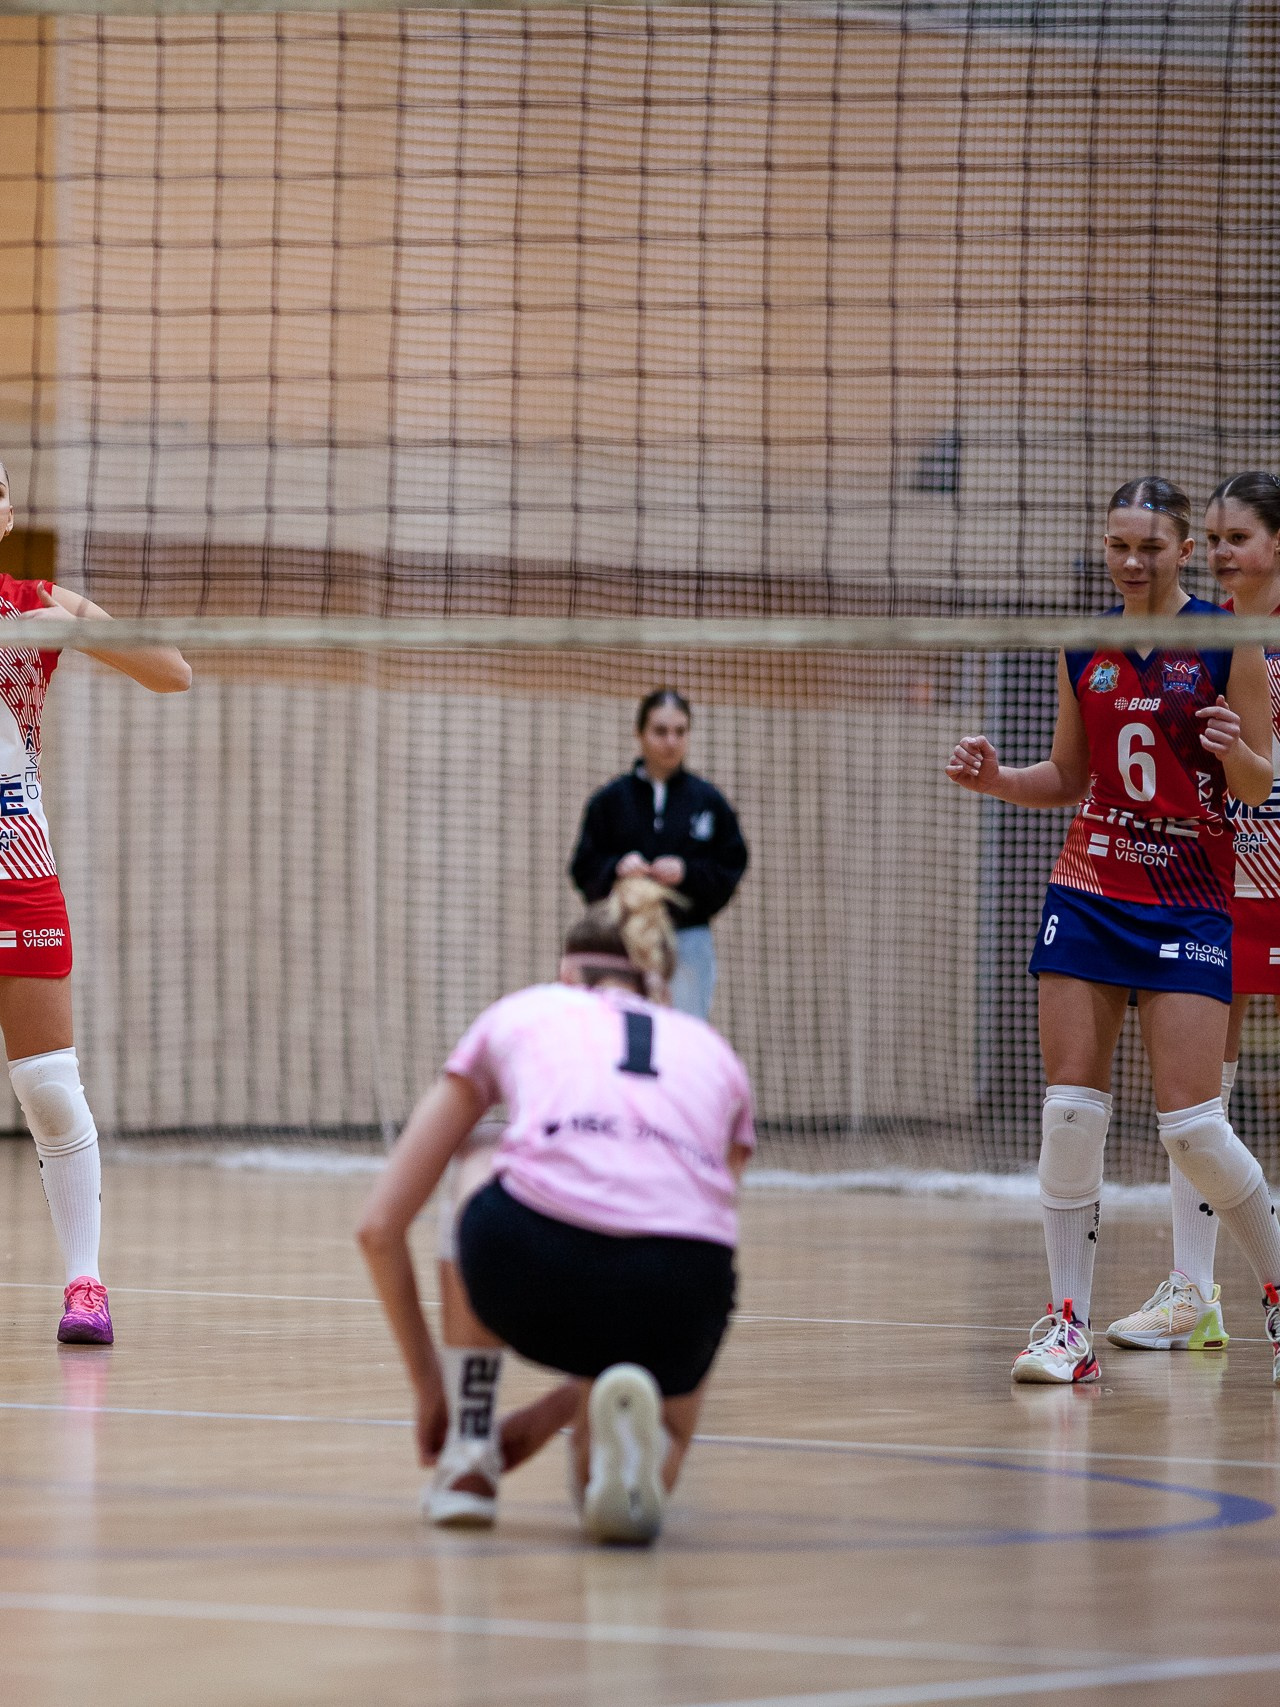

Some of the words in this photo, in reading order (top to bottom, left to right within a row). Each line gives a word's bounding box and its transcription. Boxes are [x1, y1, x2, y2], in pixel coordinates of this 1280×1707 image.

[1128, 698, 1162, 712] ВФВ
[1117, 722, 1156, 802] 6
[1233, 833, 1268, 843] OBAL
[1115, 838, 1179, 857] GLOBAL
[1114, 850, 1168, 868] VISION
[22, 928, 66, 940] GLOBAL
[1043, 914, 1059, 946] 6
[23, 937, 63, 948] VISION
[1185, 942, 1228, 960] GLOBAL
[1185, 951, 1225, 968] VISION
[617, 1010, 659, 1078] 1
